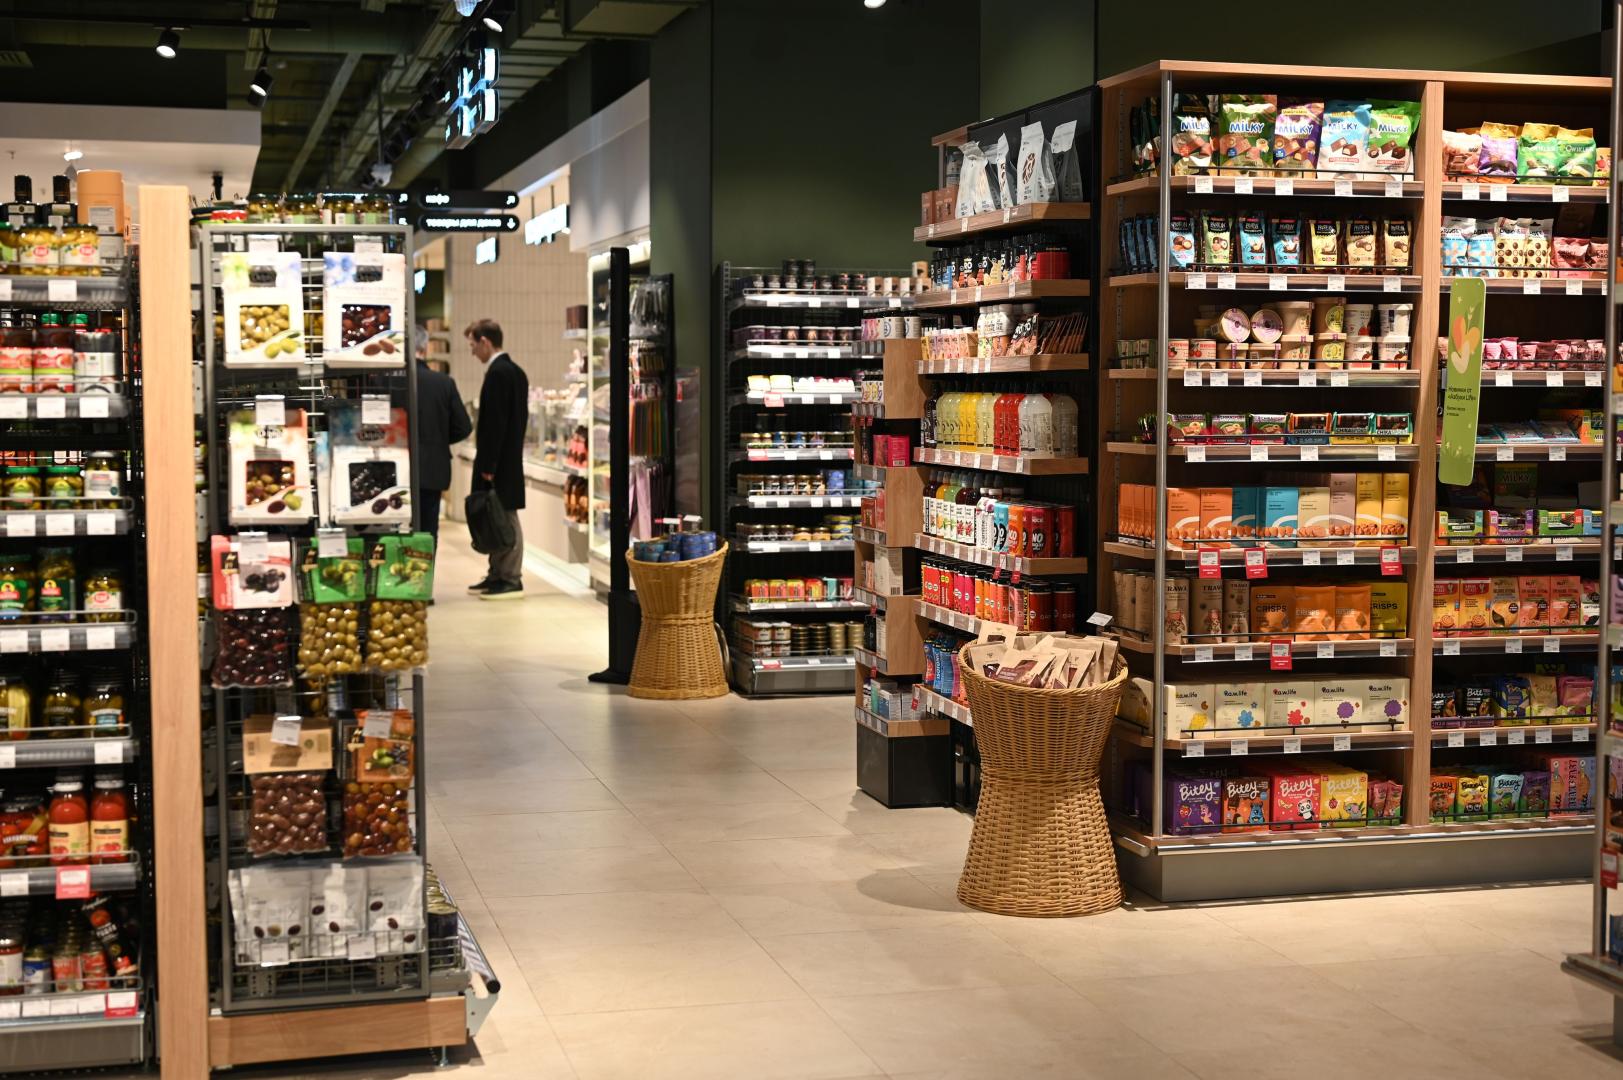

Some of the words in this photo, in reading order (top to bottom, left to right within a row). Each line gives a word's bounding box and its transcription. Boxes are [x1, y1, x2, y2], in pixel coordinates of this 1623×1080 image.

[1181, 121, 1210, 131] MILK
[1229, 120, 1264, 133] MILKY
[1278, 122, 1314, 135] MILKY
[1328, 121, 1358, 130] MILKY
[1378, 123, 1408, 132] MILKY
[1032, 532, 1044, 542] NO
[1255, 604, 1287, 613] CRISPS
[1467, 687, 1484, 697] Bite
[1179, 782, 1217, 801] Bitey
[1227, 781, 1260, 799] Bitey
[1279, 778, 1316, 798] Bitey
[1327, 776, 1363, 795] Bitey
[1499, 779, 1521, 792] Bitey
